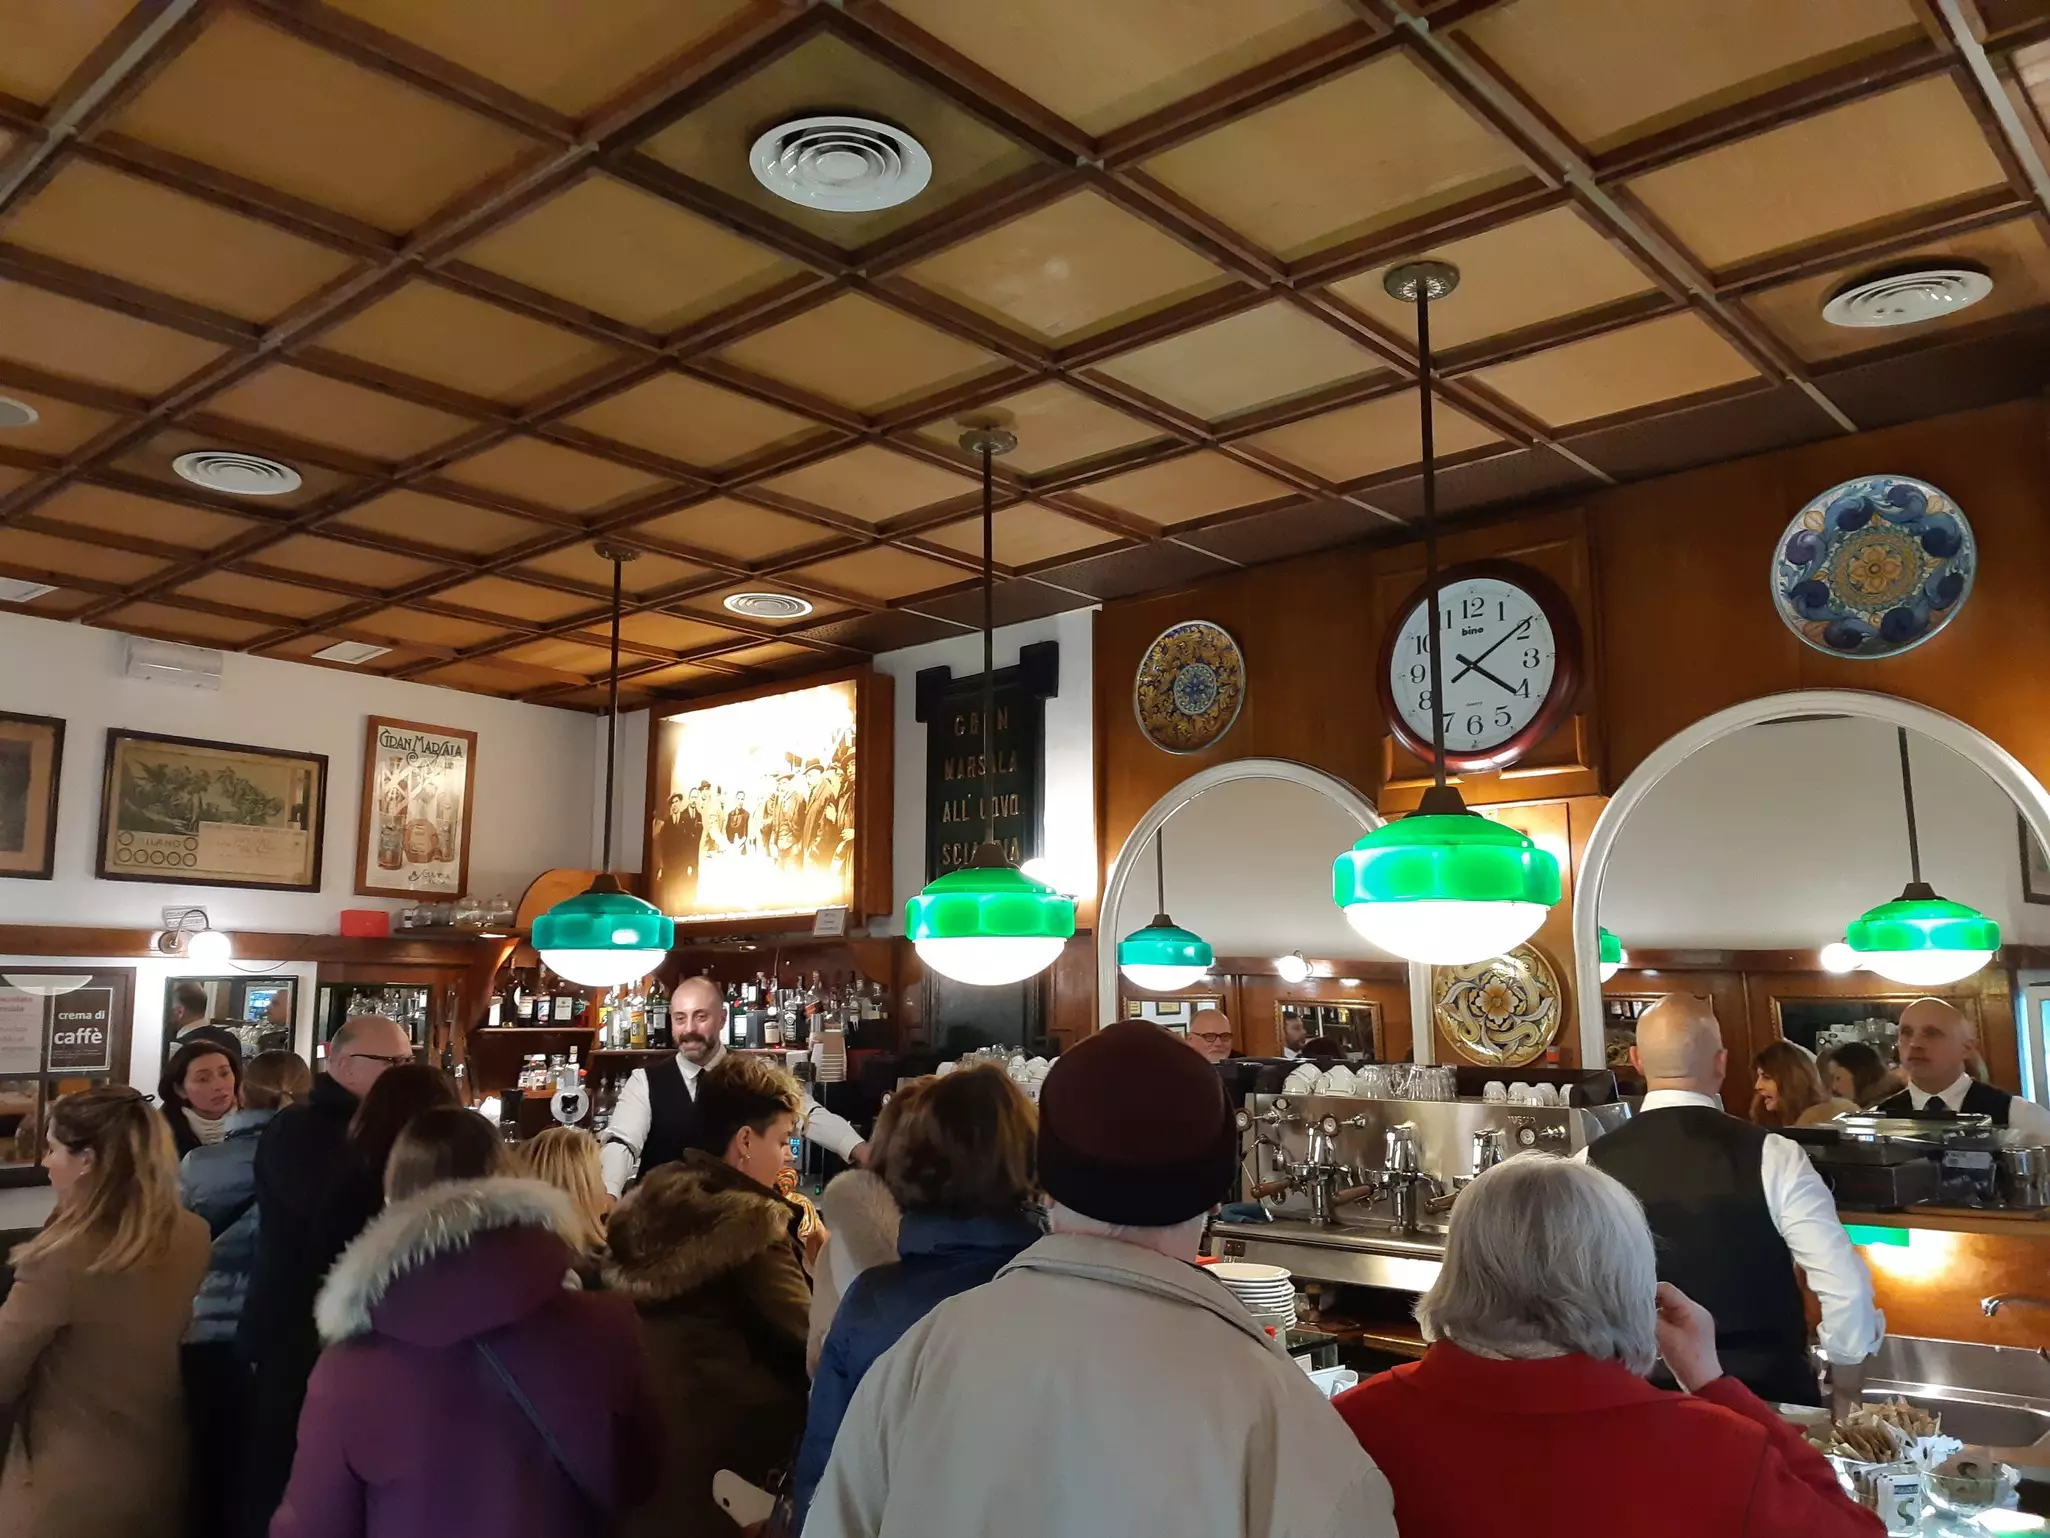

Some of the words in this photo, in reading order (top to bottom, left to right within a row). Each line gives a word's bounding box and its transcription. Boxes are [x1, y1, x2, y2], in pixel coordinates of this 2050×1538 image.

[1460, 596, 1485, 619] 12
[1496, 600, 1506, 622] 1
[1461, 625, 1484, 637] bino
[1522, 647, 1540, 669] 3
[1410, 663, 1426, 685] 9
[1516, 677, 1532, 699] 4
[1418, 690, 1433, 711] 8
[1467, 714, 1484, 737] 6
[1494, 705, 1512, 727] 5
[58, 1011, 92, 1020] crema
[94, 1010, 106, 1020] di
[54, 1027, 103, 1045] caffè
